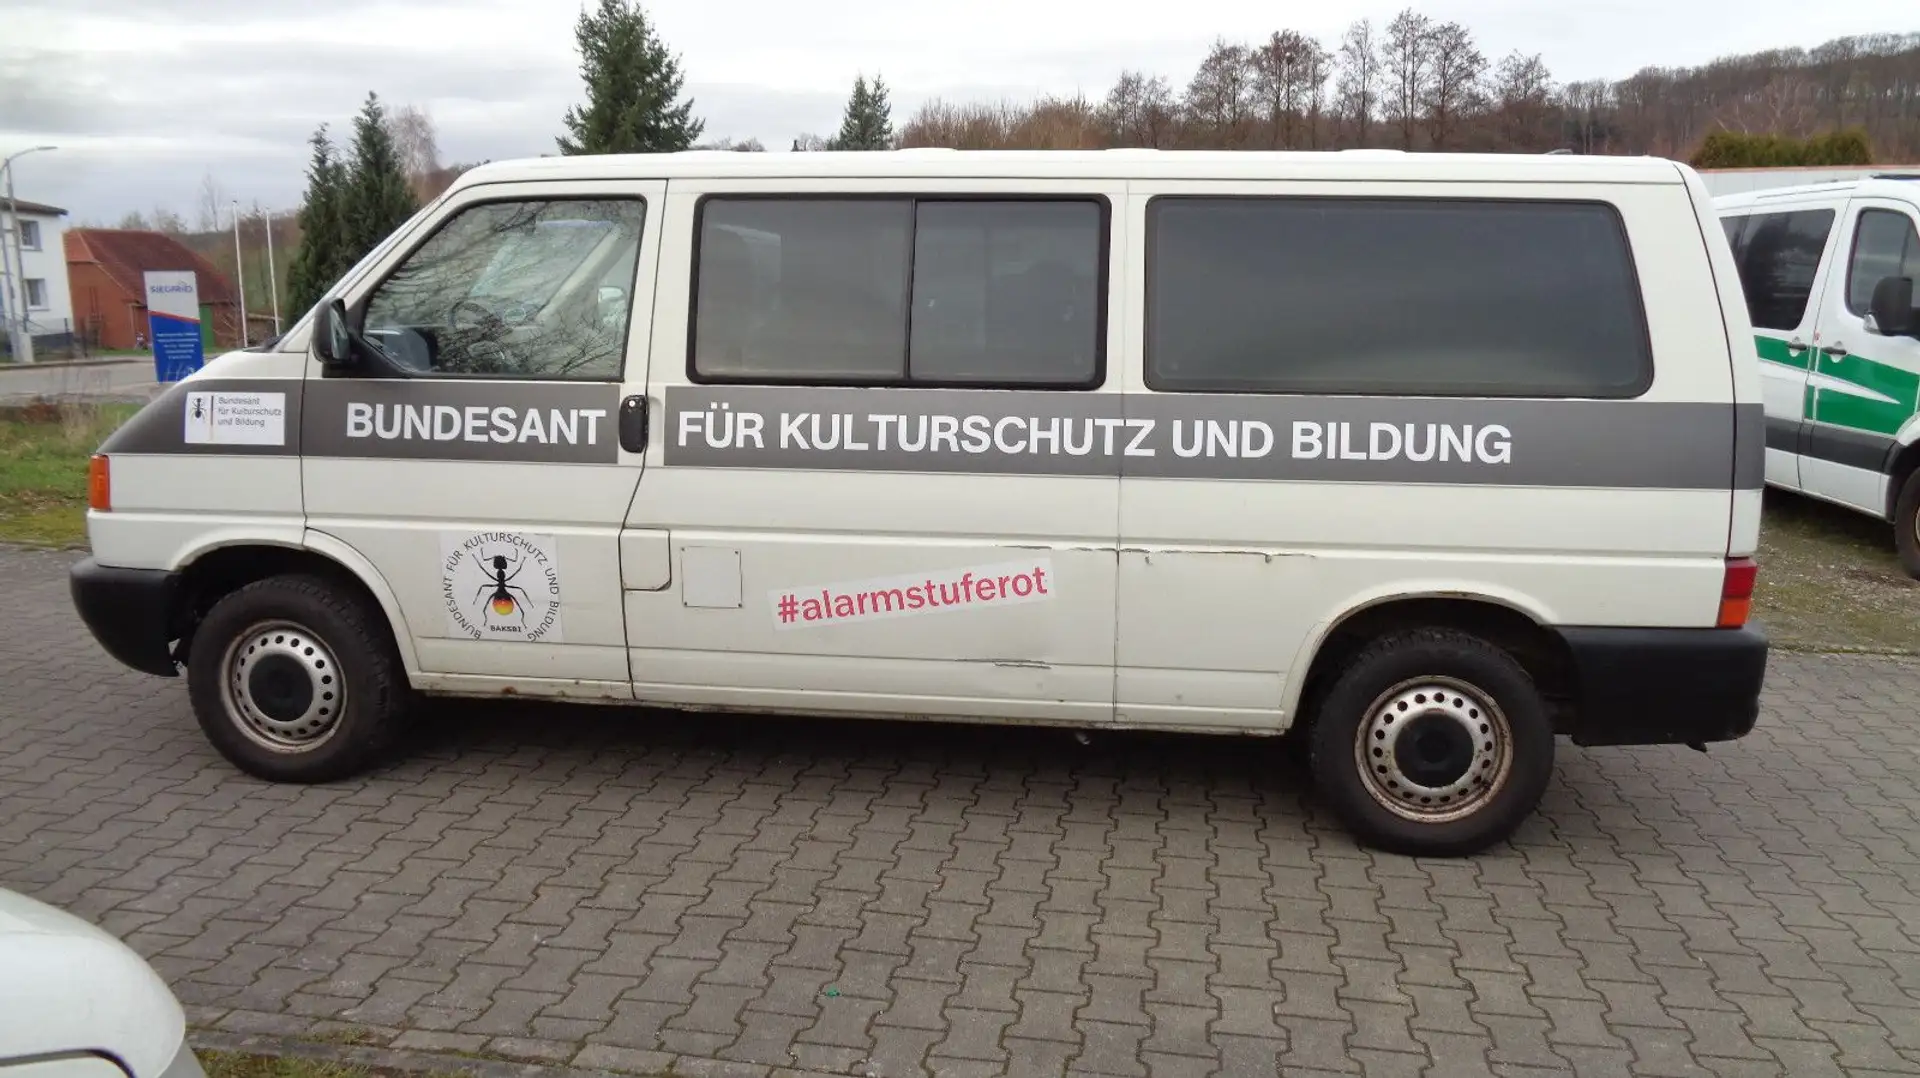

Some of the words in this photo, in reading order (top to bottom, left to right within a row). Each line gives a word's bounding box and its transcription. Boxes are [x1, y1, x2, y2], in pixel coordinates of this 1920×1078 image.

[218, 397, 260, 405] Bundesant
[218, 407, 229, 415] für
[231, 408, 282, 416] Kulturschutz
[217, 418, 233, 426] und
[235, 418, 265, 428] Bildung
[346, 402, 607, 445] BUNDESANT
[677, 402, 765, 449] FÜR
[780, 412, 1157, 457] KULTURSCHUTZ
[1172, 419, 1275, 459] UND
[1291, 420, 1513, 465] BILDUNG
[446, 550, 463, 572] FÜR
[463, 532, 549, 565] KULTURSCHUTZ
[544, 567, 559, 595] UND
[777, 566, 1048, 624] #alarmstuferot
[443, 576, 482, 641] BUNDESANT
[527, 600, 560, 642] BILDUNG
